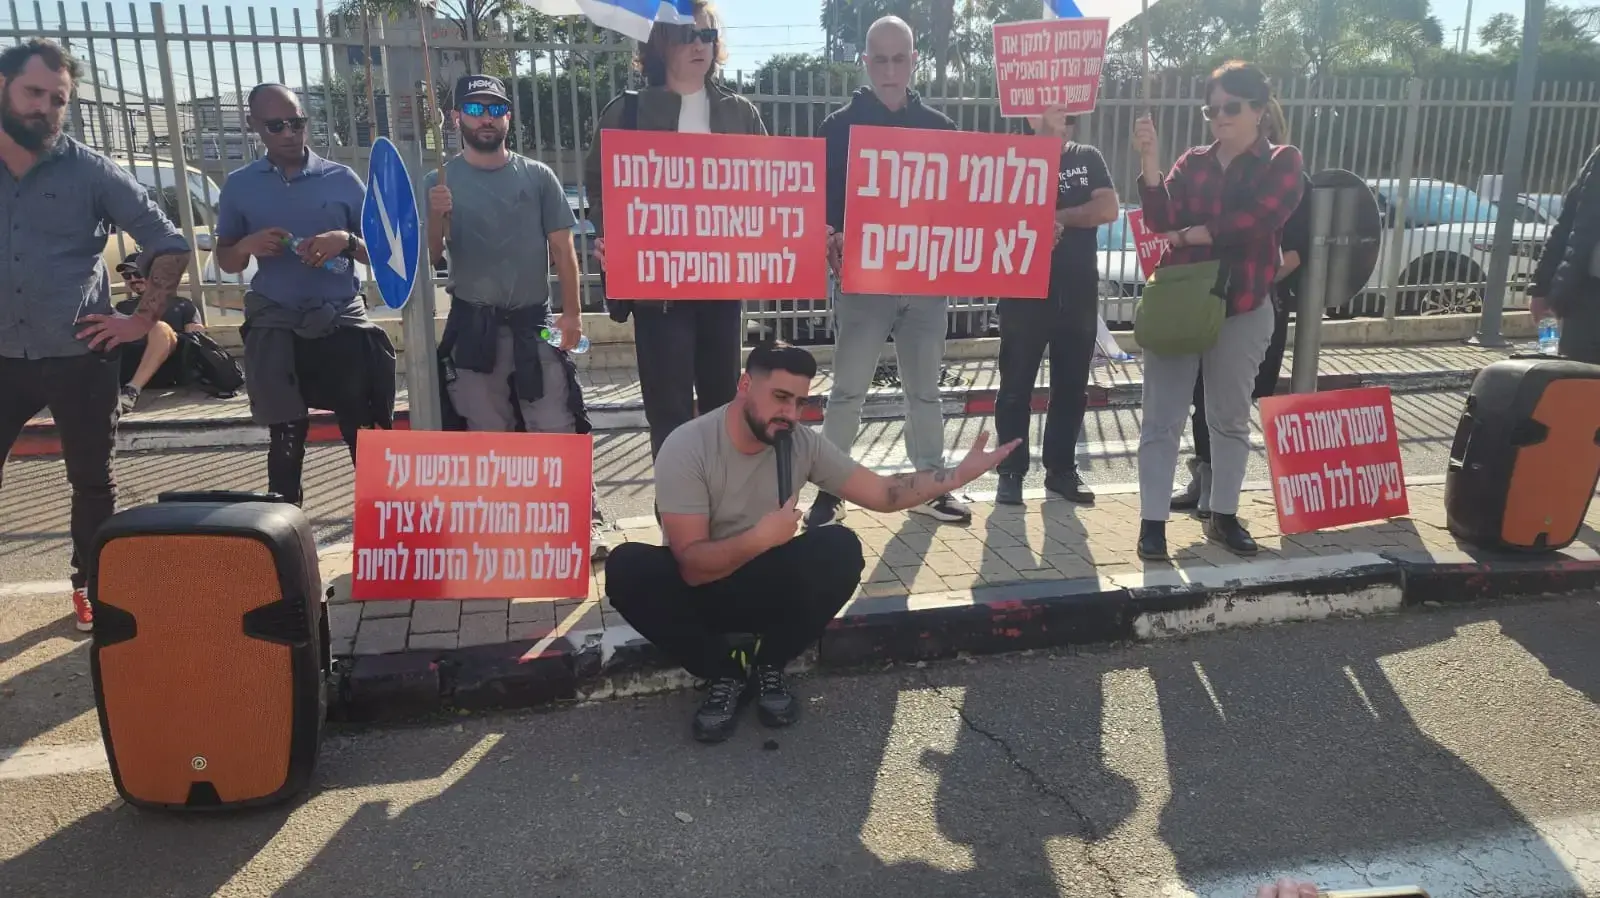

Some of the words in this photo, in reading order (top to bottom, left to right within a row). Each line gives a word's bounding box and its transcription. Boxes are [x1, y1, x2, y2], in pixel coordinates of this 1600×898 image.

[1002, 35, 1018, 55] את
[1021, 28, 1050, 56] לתקן
[1054, 30, 1080, 54] הזמן
[1082, 29, 1102, 50] הגיע
[468, 79, 498, 92] HOKA
[1000, 59, 1047, 81] והאפלייה
[1050, 57, 1080, 82] הצדק
[1010, 88, 1034, 106] שנים
[1037, 86, 1059, 105] כבר
[613, 149, 696, 189] נשלחנו
[702, 156, 815, 197] בפקודתכם
[857, 148, 948, 207] הקרב
[958, 147, 1049, 206] הלומי
[627, 197, 688, 237] תוכלו
[696, 205, 764, 238] שאתם
[770, 206, 805, 239] כדי
[736, 246, 796, 284] לחיות
[861, 223, 984, 280] שקופים
[992, 220, 1037, 275] לא
[637, 251, 731, 288] והופקרנו
[1274, 414, 1304, 455] היא
[1304, 406, 1387, 450] פוסטראומה
[385, 447, 410, 490] על
[416, 455, 469, 487] בנפשו
[476, 450, 538, 487] ששילם
[543, 457, 562, 488] מי
[1324, 460, 1354, 509] לכל
[1356, 461, 1401, 507] פציעה
[1278, 471, 1326, 516] החיים
[374, 500, 415, 539] צריך
[420, 495, 445, 533] לא
[450, 496, 519, 534] המולדת
[525, 501, 569, 534] הגנת
[356, 541, 409, 580] לחיות
[414, 548, 467, 580] הזכות
[472, 542, 498, 584] על
[502, 548, 526, 580] גם
[531, 542, 582, 580] לשלם
